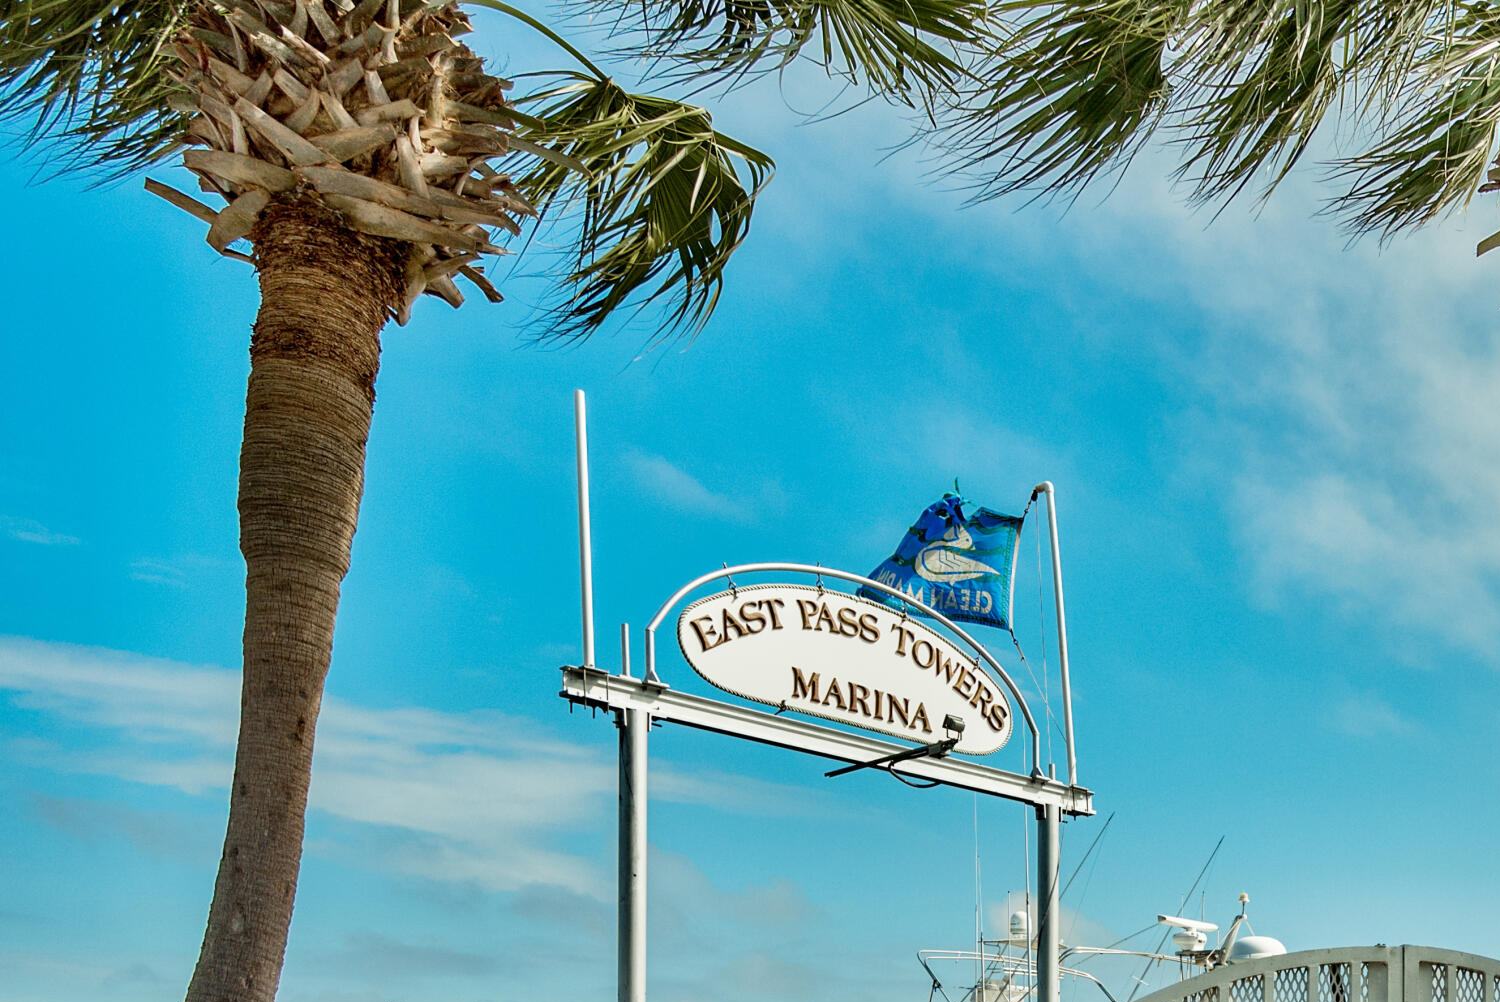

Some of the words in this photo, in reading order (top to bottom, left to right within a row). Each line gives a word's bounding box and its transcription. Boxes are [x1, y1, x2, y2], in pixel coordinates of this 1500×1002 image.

[690, 598, 785, 652] EAST
[796, 599, 881, 643] PASS
[891, 622, 1008, 732] TOWERS
[791, 666, 933, 733] MARINA
